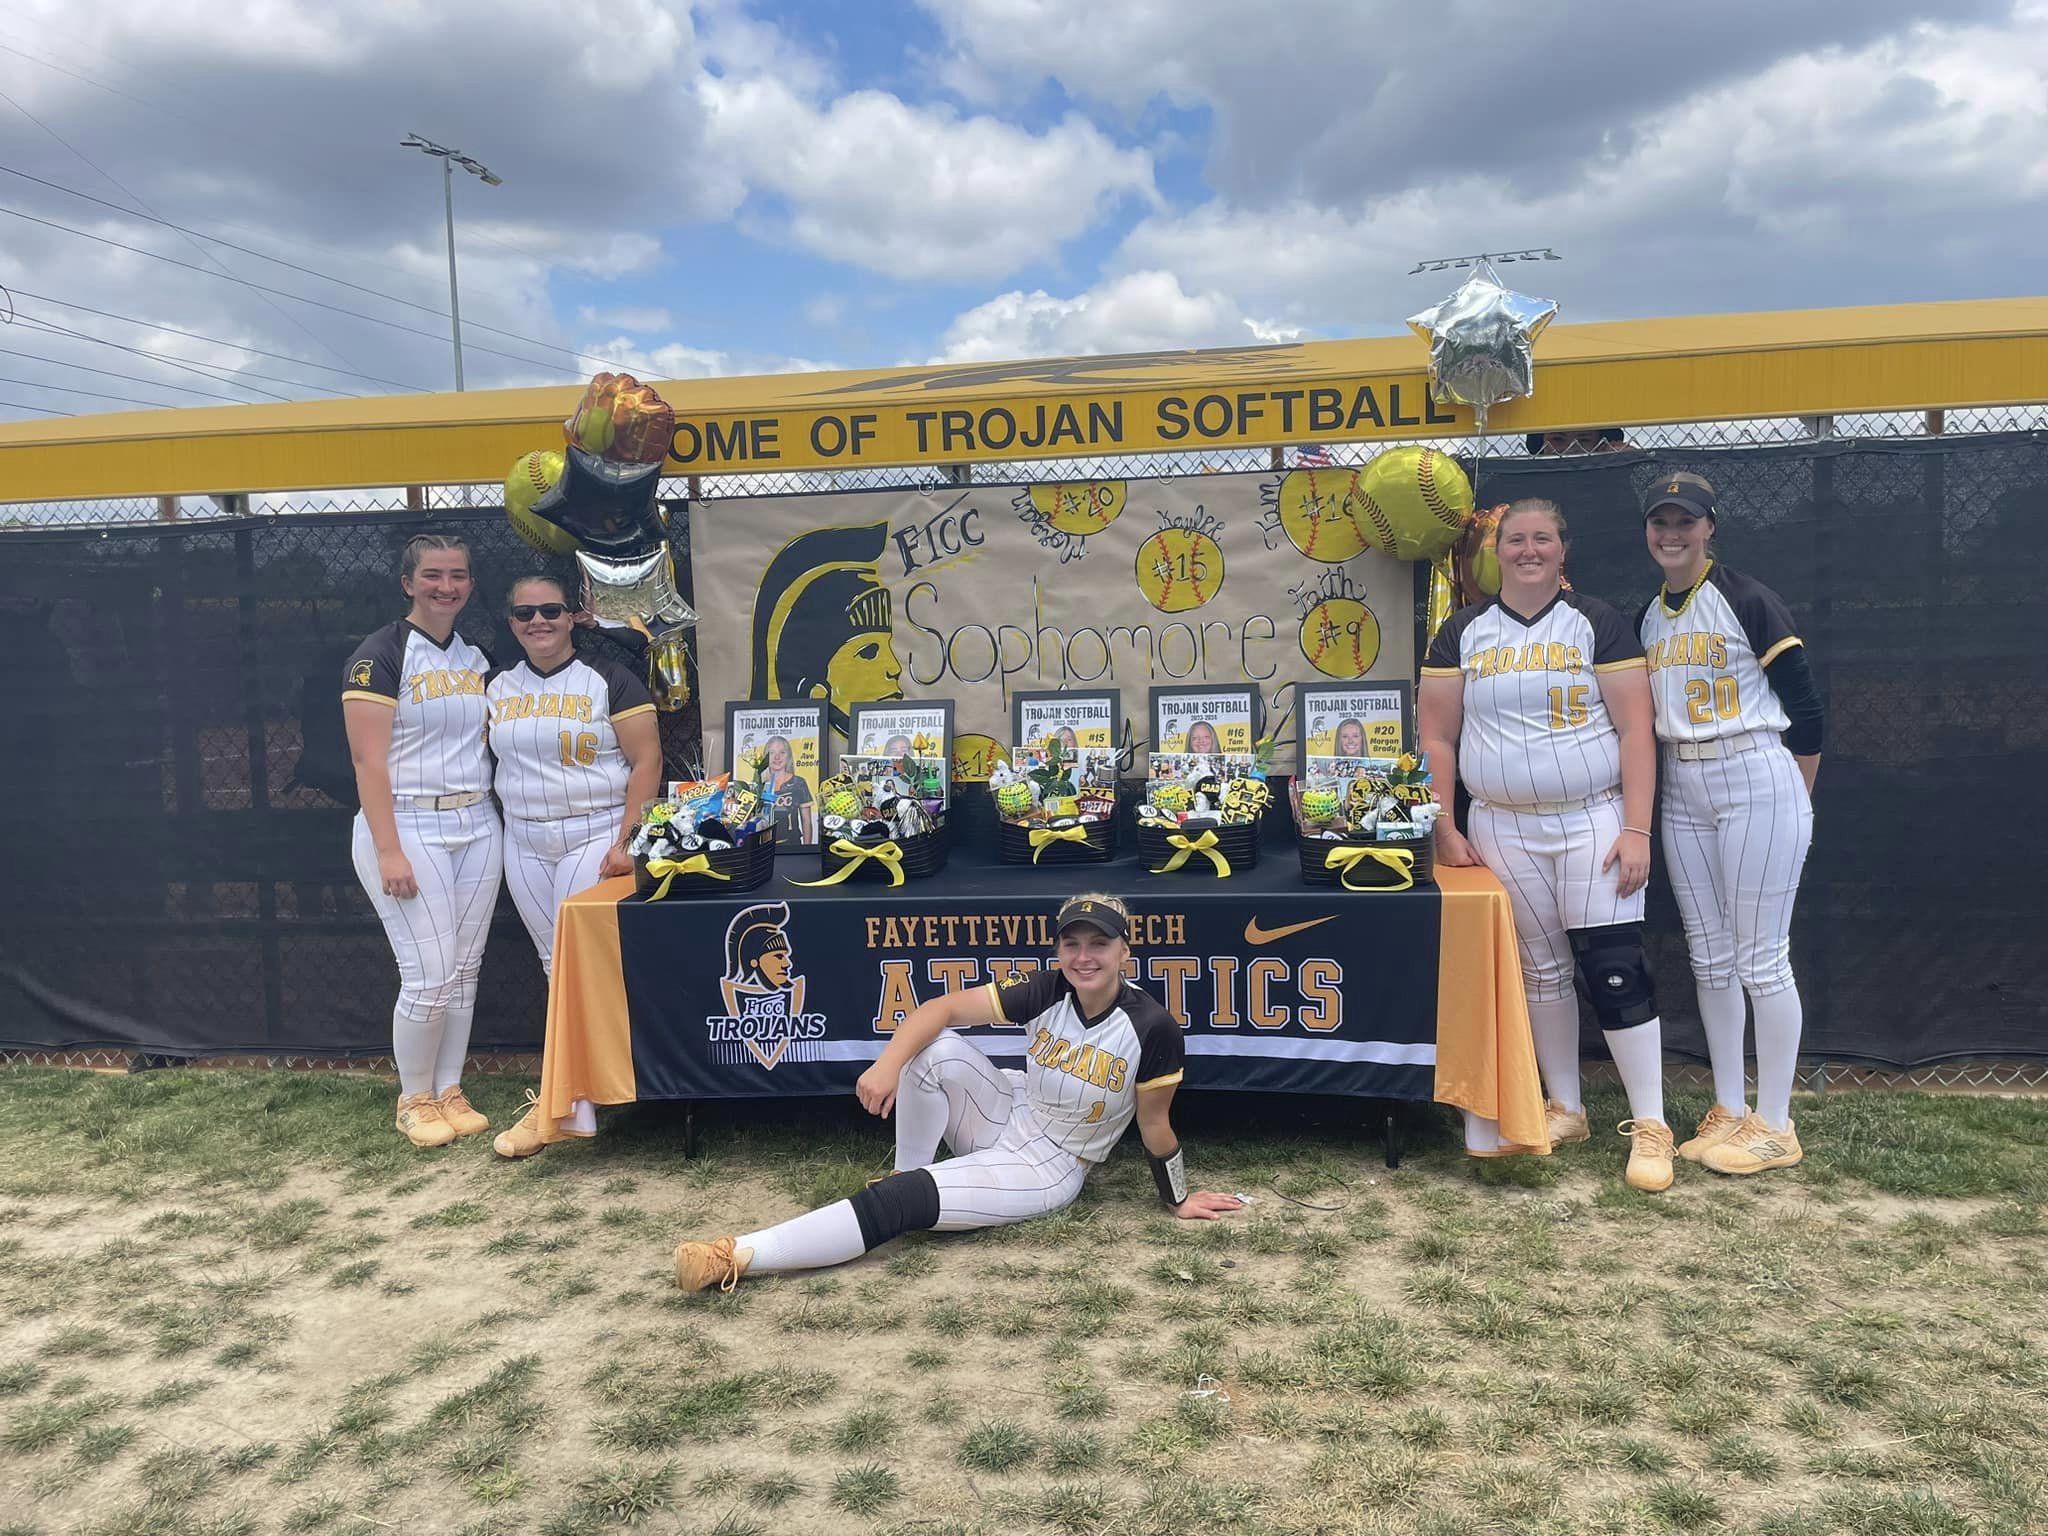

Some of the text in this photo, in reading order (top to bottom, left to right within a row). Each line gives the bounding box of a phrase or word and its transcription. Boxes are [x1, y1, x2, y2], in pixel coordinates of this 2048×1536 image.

[669, 383, 1456, 464] OME OF TROJAN SOFTBALL
[1063, 486, 1114, 518] #20
[891, 491, 985, 577] FTCC
[1152, 552, 1208, 582] #15
[1288, 565, 1368, 621] Faith
[905, 575, 1278, 713] Sophomore
[1315, 620, 1361, 653] #9
[1468, 642, 1583, 682] TROJANS
[1647, 632, 1728, 672] OJANS
[494, 694, 593, 726] TROJANS
[1026, 706, 1110, 720] TROJAN SOFTBALL
[1161, 701, 1249, 715] TROJAN SOFTBALL
[1308, 698, 1400, 712] TROJAN SOFTBALL
[1547, 684, 1591, 730] 15
[1684, 676, 1741, 725] 20
[740, 716, 775, 730] TROJAN
[861, 716, 944, 730] TROJAN SOFTBALL
[1088, 733, 1105, 743] #15
[1227, 728, 1245, 738] #16
[1374, 726, 1395, 735] #20
[558, 731, 599, 767] 16
[1370, 737, 1399, 746] Morgan
[682, 783, 718, 803] heetos
[1200, 783, 1220, 793] GRAD
[865, 914, 1186, 948] FAYETTEVIL ECH
[745, 994, 786, 1016] FTCC
[873, 955, 1344, 1034] ATTICS
[706, 1013, 828, 1041] TROJANS
[1086, 1101, 1106, 1124] 1
